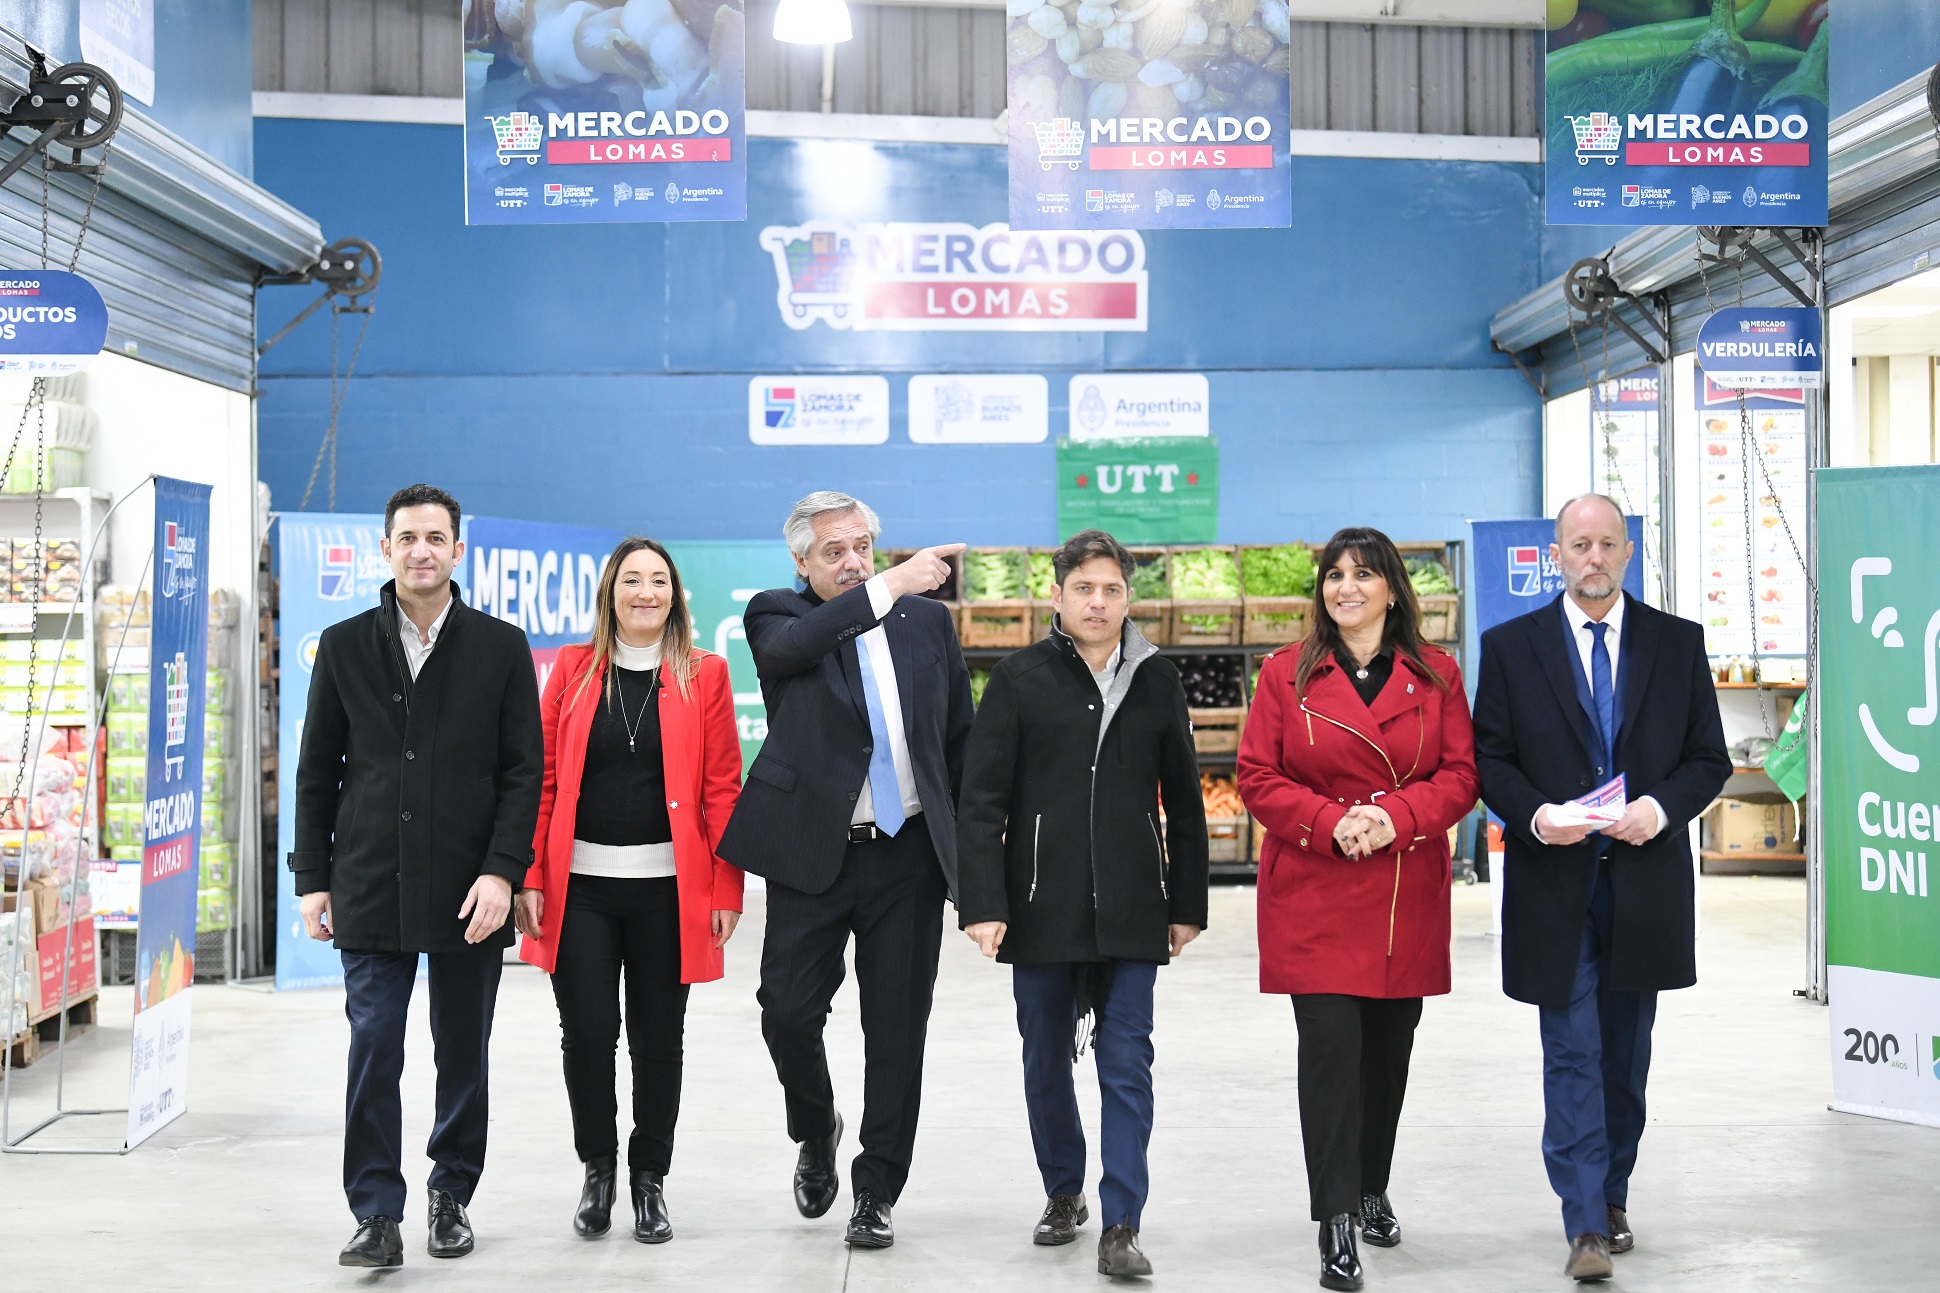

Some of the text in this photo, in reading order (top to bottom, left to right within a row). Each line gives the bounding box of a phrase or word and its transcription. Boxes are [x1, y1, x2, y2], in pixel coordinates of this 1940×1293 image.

[548, 109, 729, 138] MERCADO
[1090, 116, 1272, 143] MERCADO
[1627, 113, 1809, 140] MERCADO
[589, 143, 685, 161] LOMAS
[1131, 149, 1227, 167] LOMAS
[1668, 146, 1763, 163] LOMAS
[682, 187, 723, 198] Argentina
[1224, 194, 1265, 204] Argentina
[1760, 192, 1801, 202] Argentina
[500, 200, 523, 208] UTT
[1041, 205, 1064, 213] UTT
[1577, 200, 1600, 208] UTT
[867, 233, 1135, 275] MERCADO
[926, 287, 1069, 316] LOMAS
[1750, 320, 1786, 328] MERCADO
[1701, 338, 1817, 357] VERDULERÍA
[801, 393, 843, 402] LOMAS
[802, 402, 855, 412] ZAMORA
[1115, 397, 1202, 418] Argentina
[1096, 463, 1180, 494] UTT
[145, 789, 194, 841] MERCADO
[153, 844, 182, 878] LOMAS
[1859, 846, 1929, 897] DNI
[1843, 1027, 1900, 1065] 200
[1891, 1059, 1908, 1070] AÑOS
